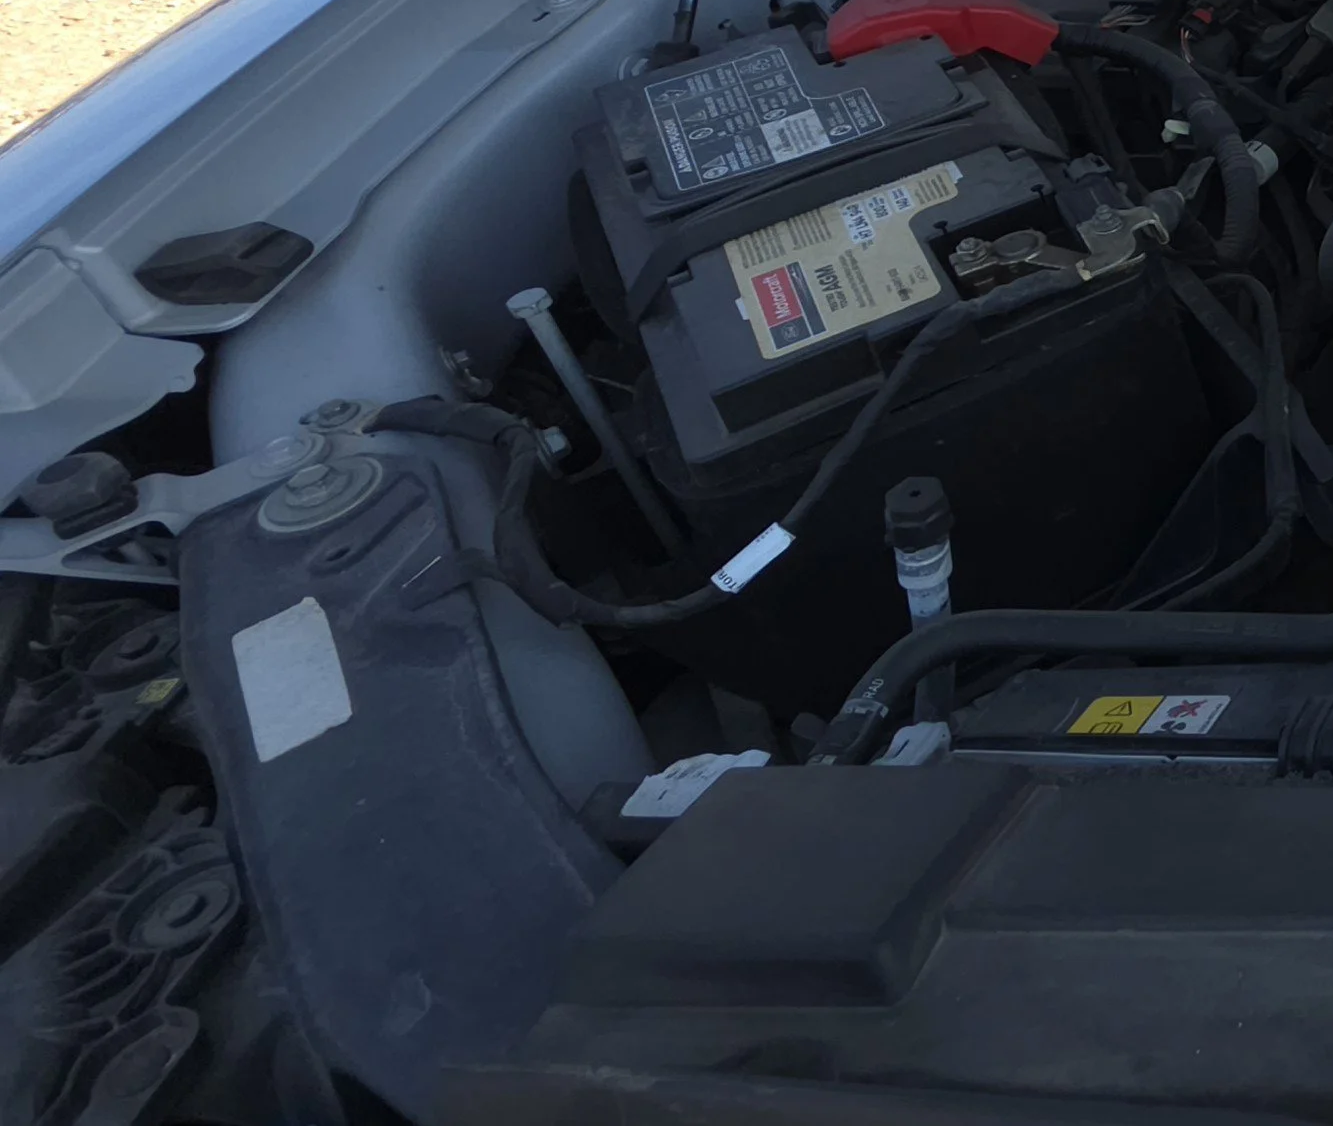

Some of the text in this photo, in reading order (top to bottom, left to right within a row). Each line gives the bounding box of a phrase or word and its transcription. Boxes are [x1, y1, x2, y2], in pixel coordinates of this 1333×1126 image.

[815, 264, 840, 292] AGM
[763, 271, 791, 320] Motorcraft
[862, 677, 885, 699] RAD
